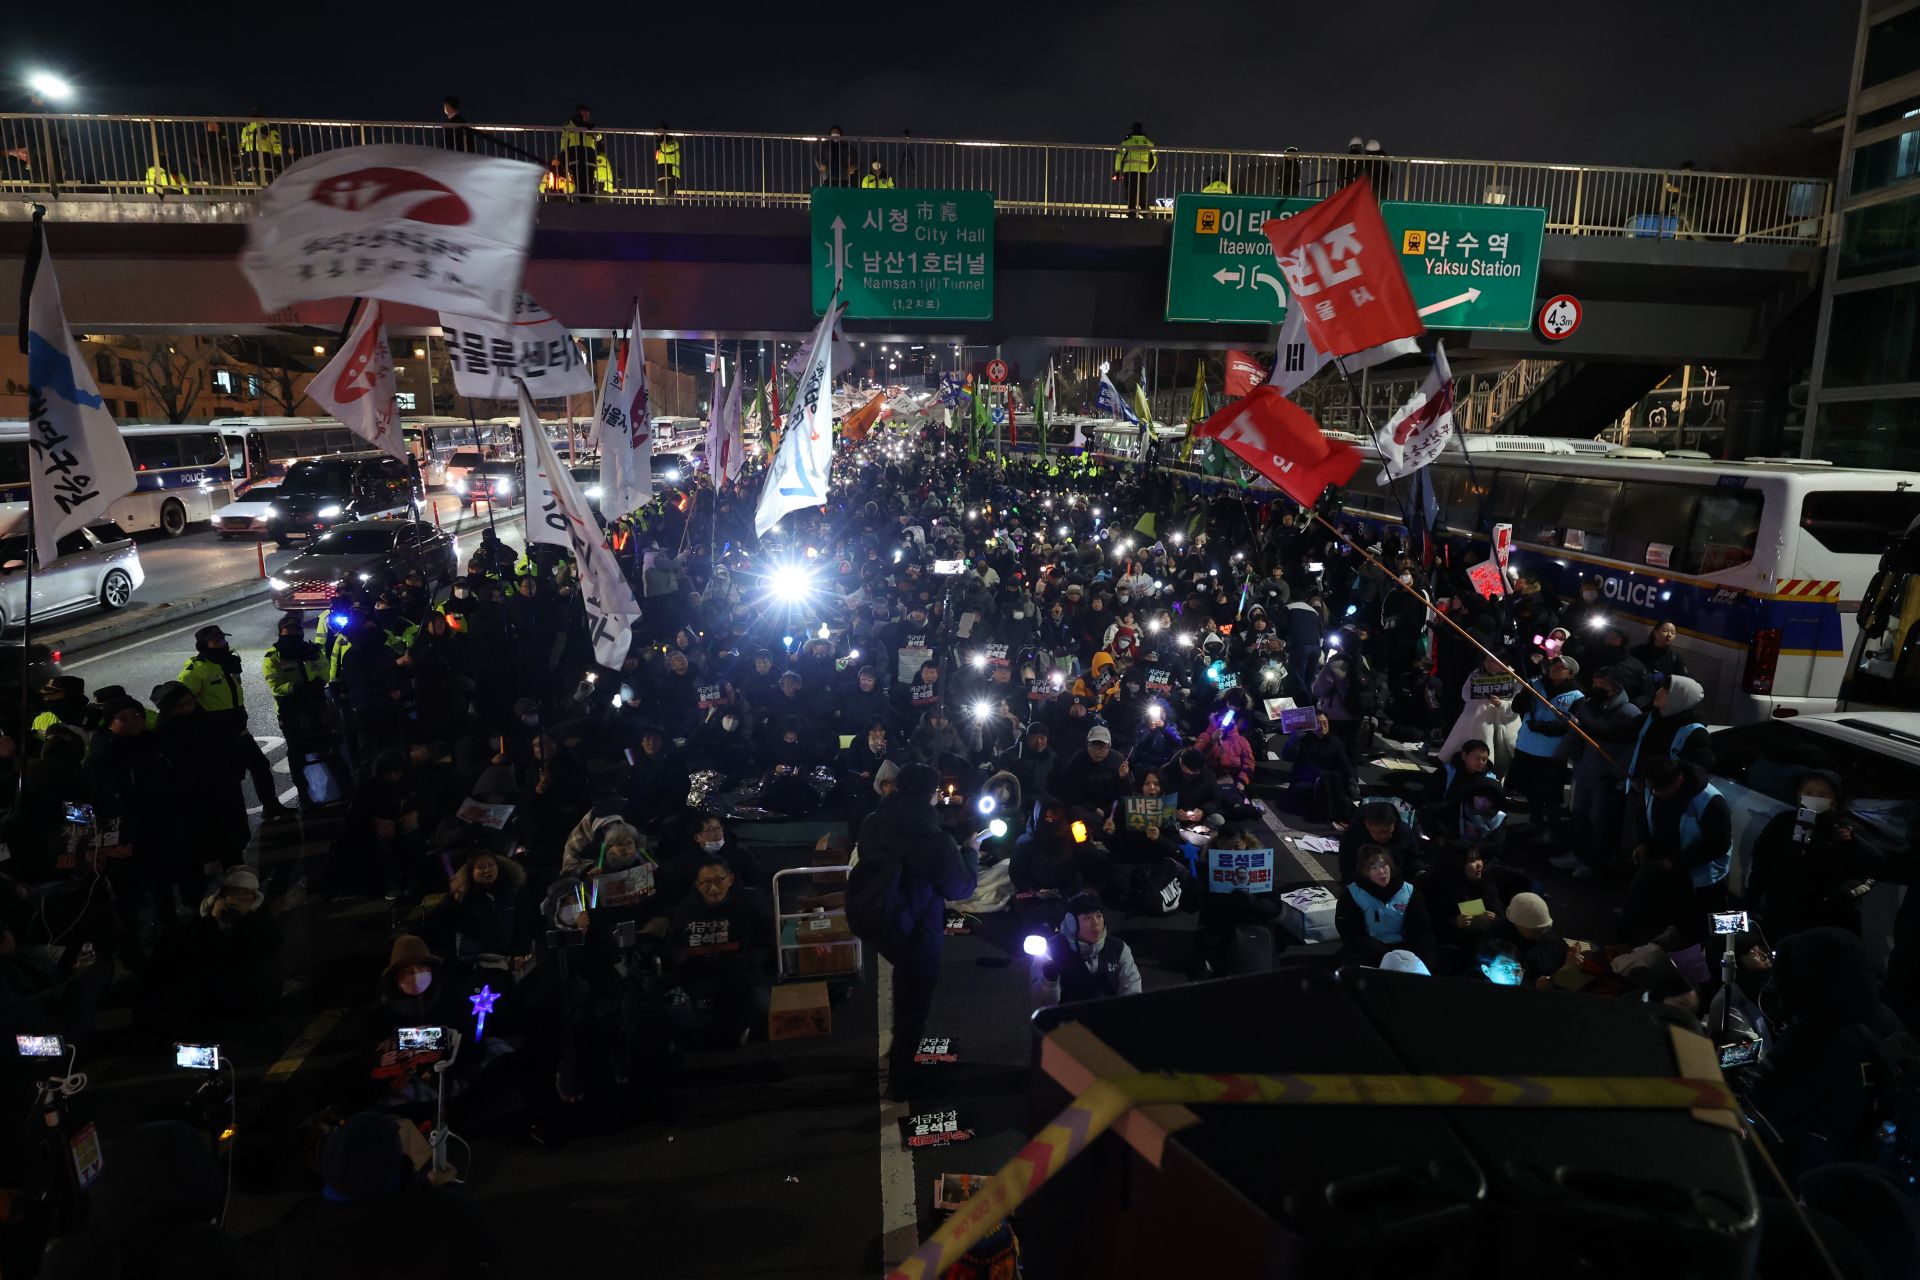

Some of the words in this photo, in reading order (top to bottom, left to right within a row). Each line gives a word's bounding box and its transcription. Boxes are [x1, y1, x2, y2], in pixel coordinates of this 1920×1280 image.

[862, 208, 908, 233] 시청
[915, 227, 948, 245] City
[957, 227, 985, 242] Hall
[1220, 237, 1273, 255] Itaewon
[863, 251, 985, 275] 남산1호터널
[1425, 258, 1468, 276] Yaksu
[1471, 259, 1521, 277] Station
[863, 277, 916, 290] Namsan
[943, 277, 985, 290] Tunnel
[1547, 309, 1573, 326] 4.3m
[181, 472, 205, 484] POLICE
[1594, 574, 1657, 608] POLICE
[1219, 854, 1265, 868] 윤석열
[1160, 877, 1182, 905] NIKE
[908, 1110, 958, 1125] 지금당장
[915, 1119, 958, 1136] 윤석열
